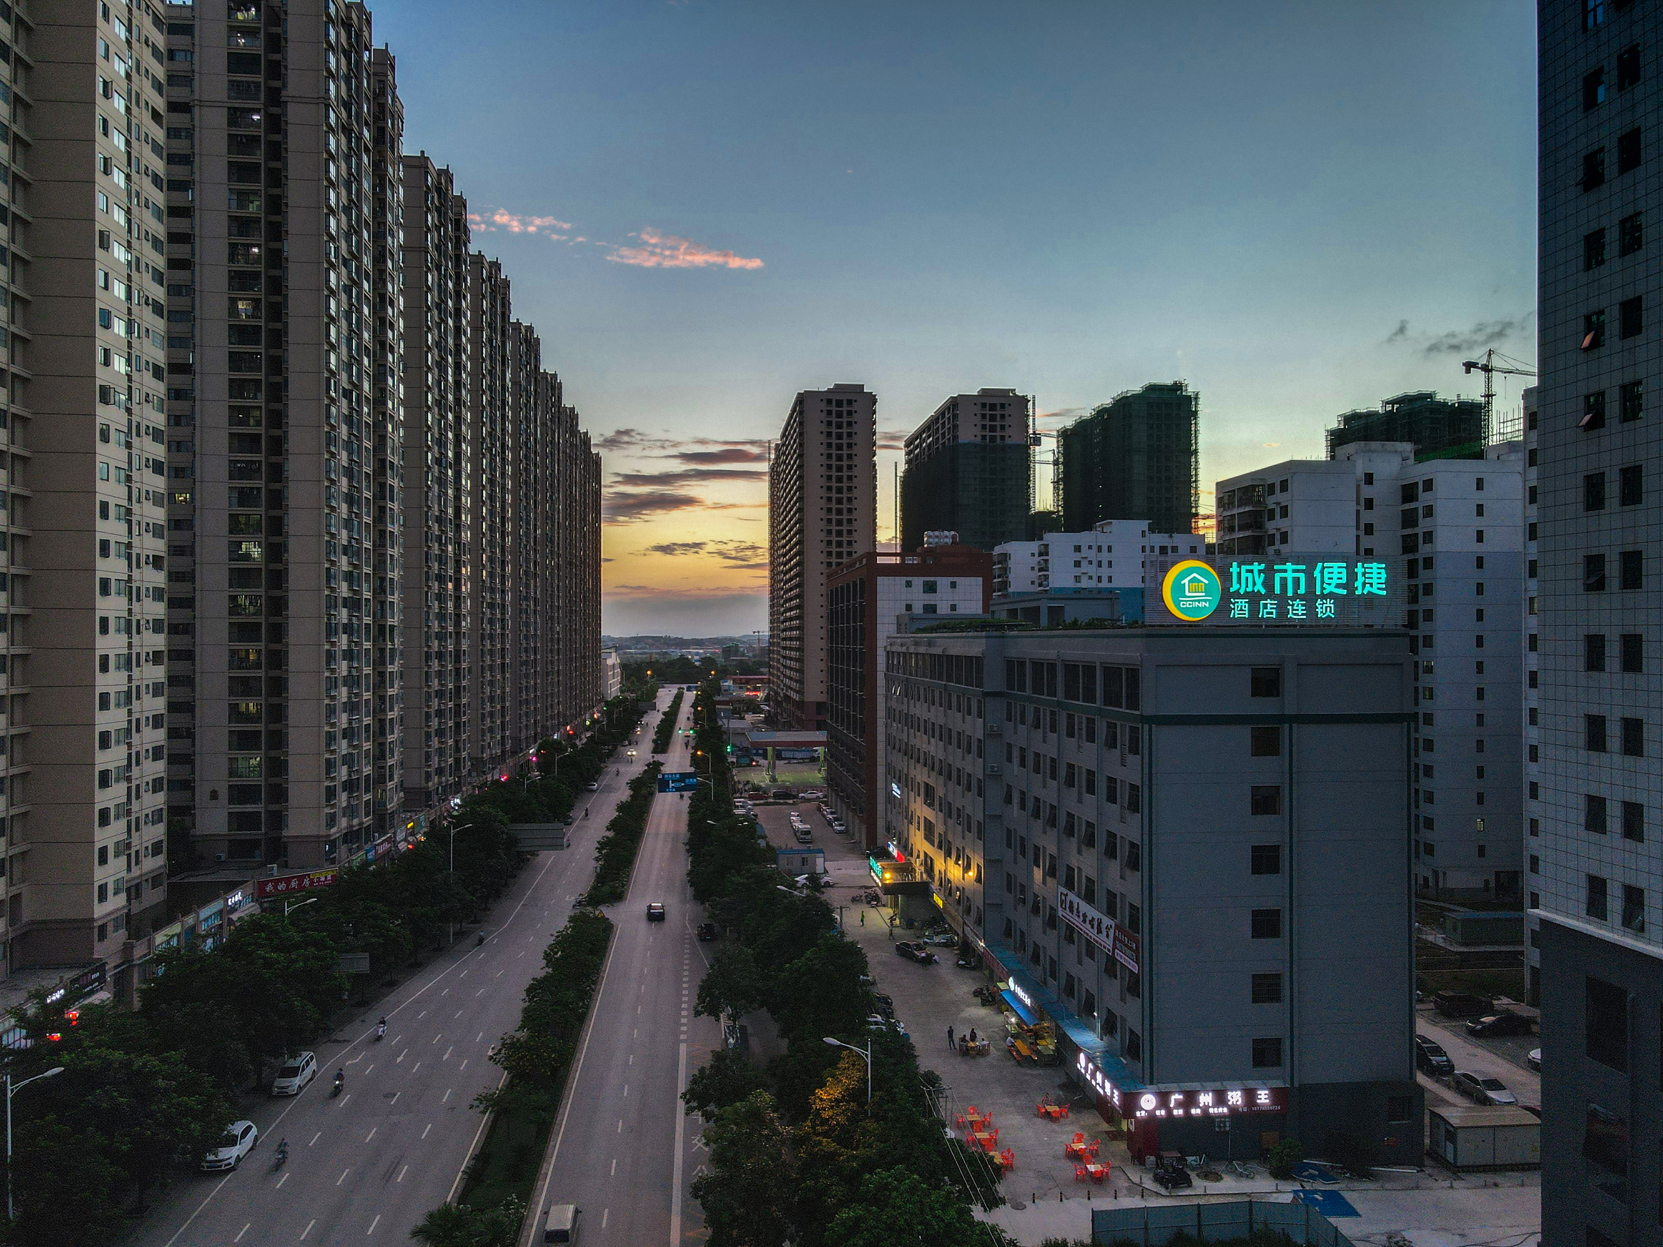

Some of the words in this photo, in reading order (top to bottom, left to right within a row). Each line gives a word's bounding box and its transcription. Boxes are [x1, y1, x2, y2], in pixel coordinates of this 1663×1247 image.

[1229, 561, 1387, 596] 城市便捷
[1229, 598, 1335, 619] 酒店连锁
[1169, 1090, 1270, 1108] 广州粥王
